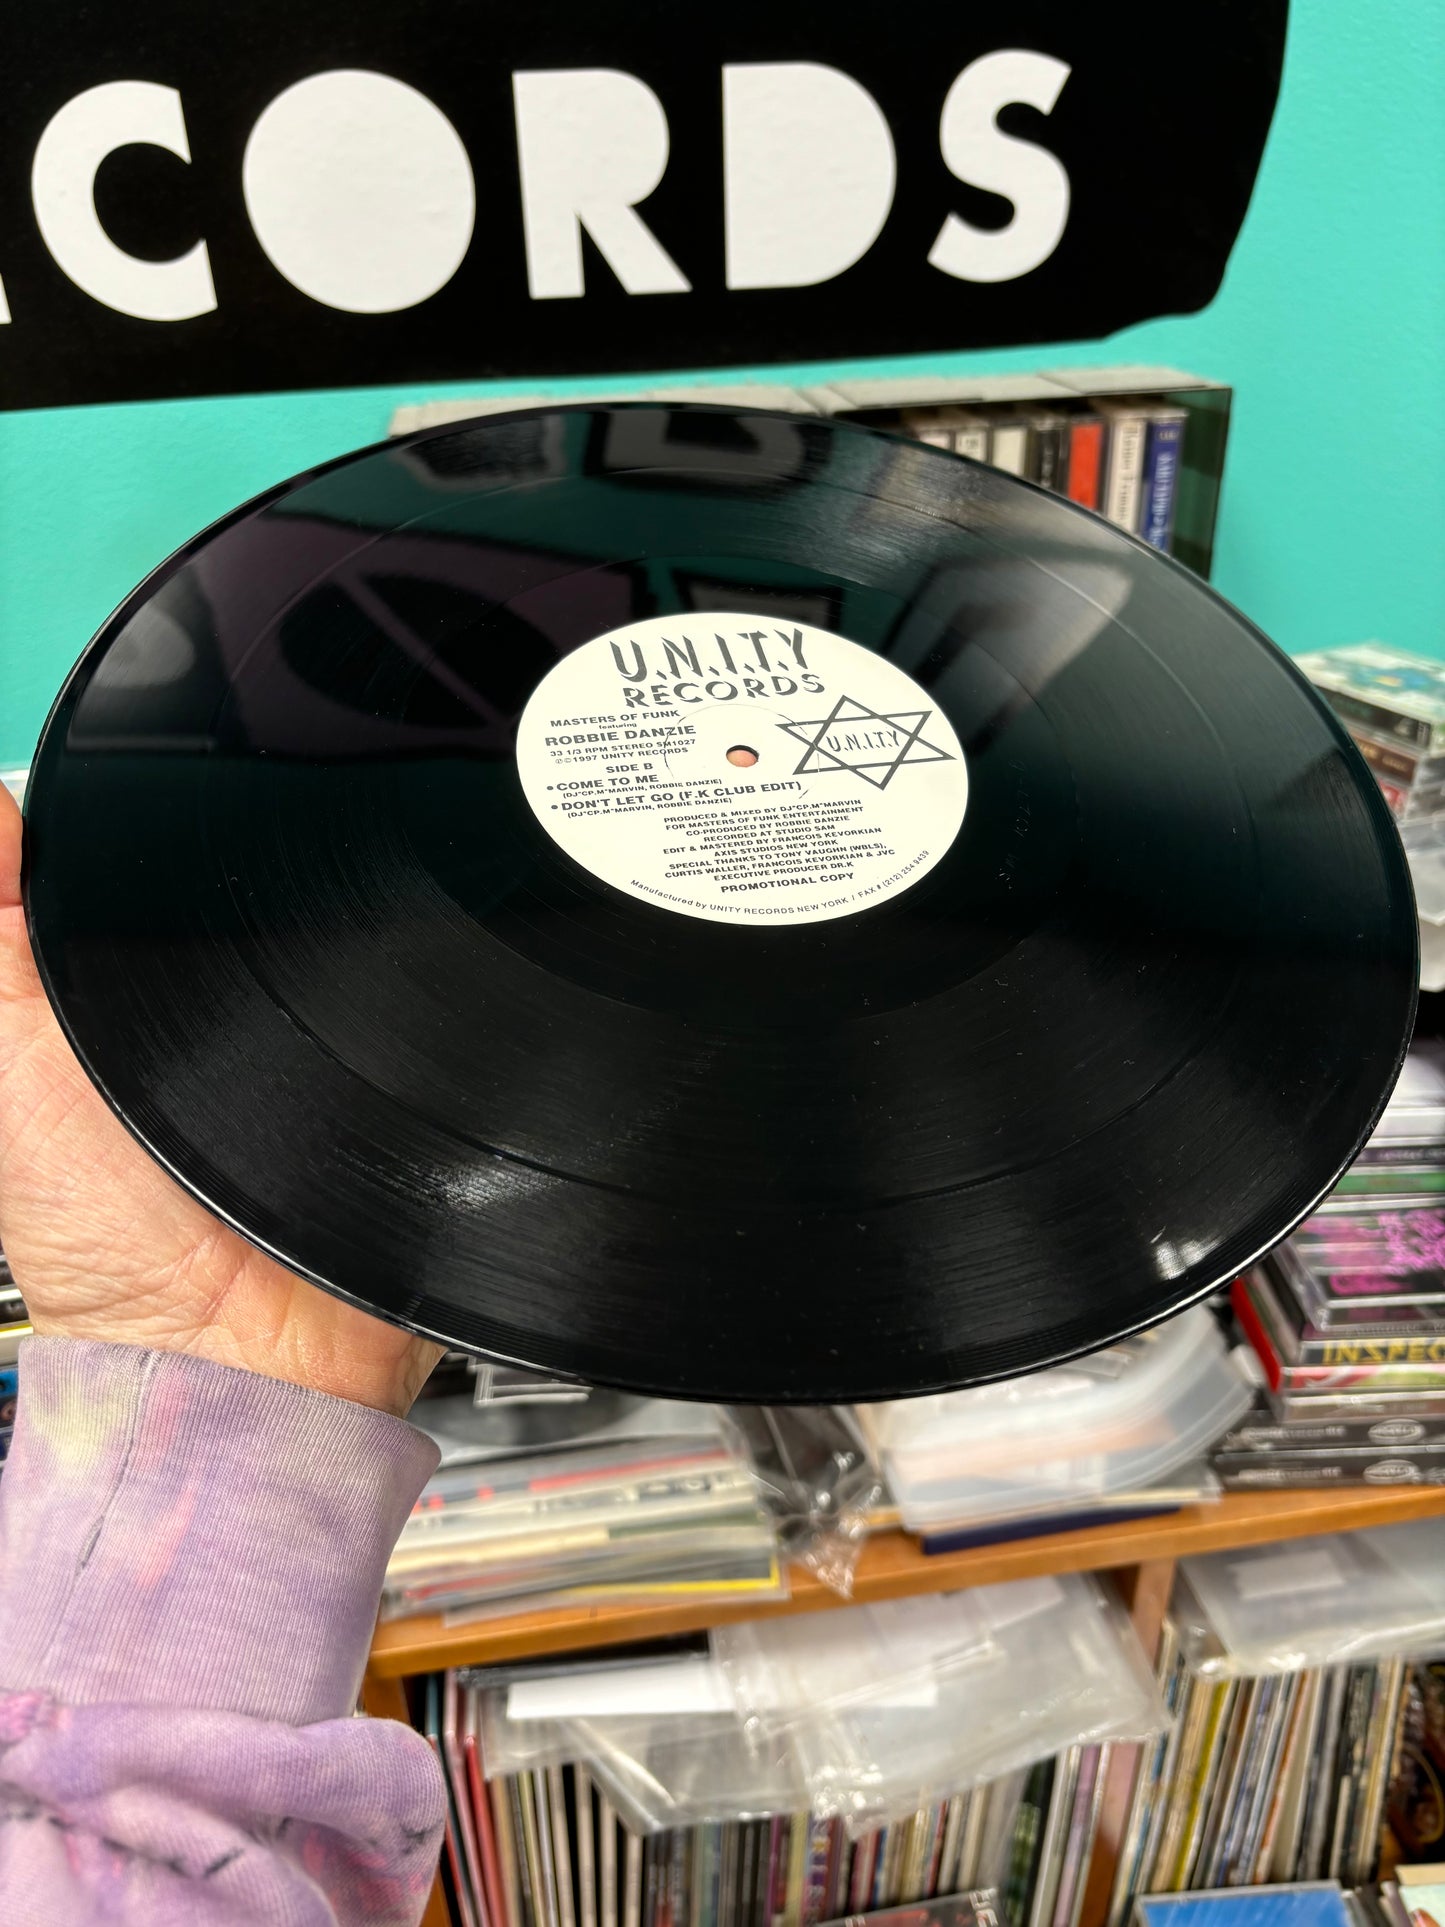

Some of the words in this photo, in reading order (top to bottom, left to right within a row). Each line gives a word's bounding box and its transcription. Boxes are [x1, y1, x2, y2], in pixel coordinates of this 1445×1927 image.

[0, 48, 1072, 323] CORDS
[622, 673, 826, 709] RECORDS
[550, 714, 616, 727] MASTERS
[620, 713, 638, 721] OF
[642, 710, 681, 720] FUNK
[598, 722, 638, 730] featuring
[545, 731, 620, 747] ROBBIE
[625, 725, 697, 740] DANZIE
[585, 746, 608, 754] RPM
[611, 742, 653, 751] STEREO
[656, 739, 696, 748] SM1027
[602, 751, 634, 760] UNITY
[638, 747, 689, 757] RECORDS
[605, 763, 639, 773] SIDE
[643, 762, 654, 770] B
[556, 779, 604, 791] COME
[608, 777, 630, 786] TO
[635, 774, 659, 784] ME
[649, 781, 683, 790] ROBBIE
[686, 778, 722, 787] DANZIE)
[561, 798, 610, 811] DON'T
[616, 795, 646, 806] LET
[651, 792, 674, 802] GO
[679, 789, 710, 801] (F.K
[713, 785, 756, 797] CLUB
[760, 781, 802, 792] EDIT)
[657, 800, 693, 809] ROBBIE
[695, 797, 732, 806] DANZIE)
[664, 812, 718, 823] PRODUCED
[730, 808, 762, 817] MIXED
[665, 823, 686, 831] FOR
[688, 818, 735, 828] MASTERS
[738, 816, 750, 824] OF
[753, 814, 780, 822] FUNK
[782, 806, 864, 820] ENTERTAINMENT
[685, 824, 757, 837] CO-PRODUCED
[775, 818, 812, 828] ROBBIE
[814, 815, 850, 824] DANZIE
[703, 831, 757, 843] RECORDED
[775, 826, 812, 836] STUDIO
[814, 824, 836, 832] SAM
[663, 846, 686, 855] EDIT
[700, 839, 754, 851] MASTERED
[772, 832, 822, 844] FRANCOIS
[825, 827, 882, 838] KEVORKIAN
[714, 849, 738, 857] AXIS
[740, 844, 784, 855] STUDIOS
[810, 839, 839, 847] YORK
[665, 869, 703, 879] CURTIS
[705, 864, 750, 874] WALLER,
[752, 858, 802, 869] FRANCOIS
[805, 852, 864, 864] KEVORKIAN
[876, 849, 896, 857] JVC
[669, 860, 712, 870] SPECIAL
[714, 856, 756, 865] THANKS
[774, 851, 802, 860] TONY
[805, 846, 847, 856] VAUGHN
[849, 842, 887, 852] (WBLS),
[714, 869, 771, 881] EXECUTIVE
[773, 863, 828, 875] PRODUCER
[830, 861, 854, 869] DR.K
[630, 879, 694, 906] Manufactured
[695, 901, 708, 909] by
[709, 904, 741, 914] UNITY
[744, 907, 795, 915] RECORDS
[796, 903, 819, 913] NEW
[821, 897, 849, 909] YORK
[857, 886, 876, 898] FAX
[882, 872, 904, 888] (212)
[901, 863, 915, 875] 254
[912, 850, 930, 865] 9439
[721, 877, 817, 893] PROMOTIONAL
[819, 872, 854, 883] COPY
